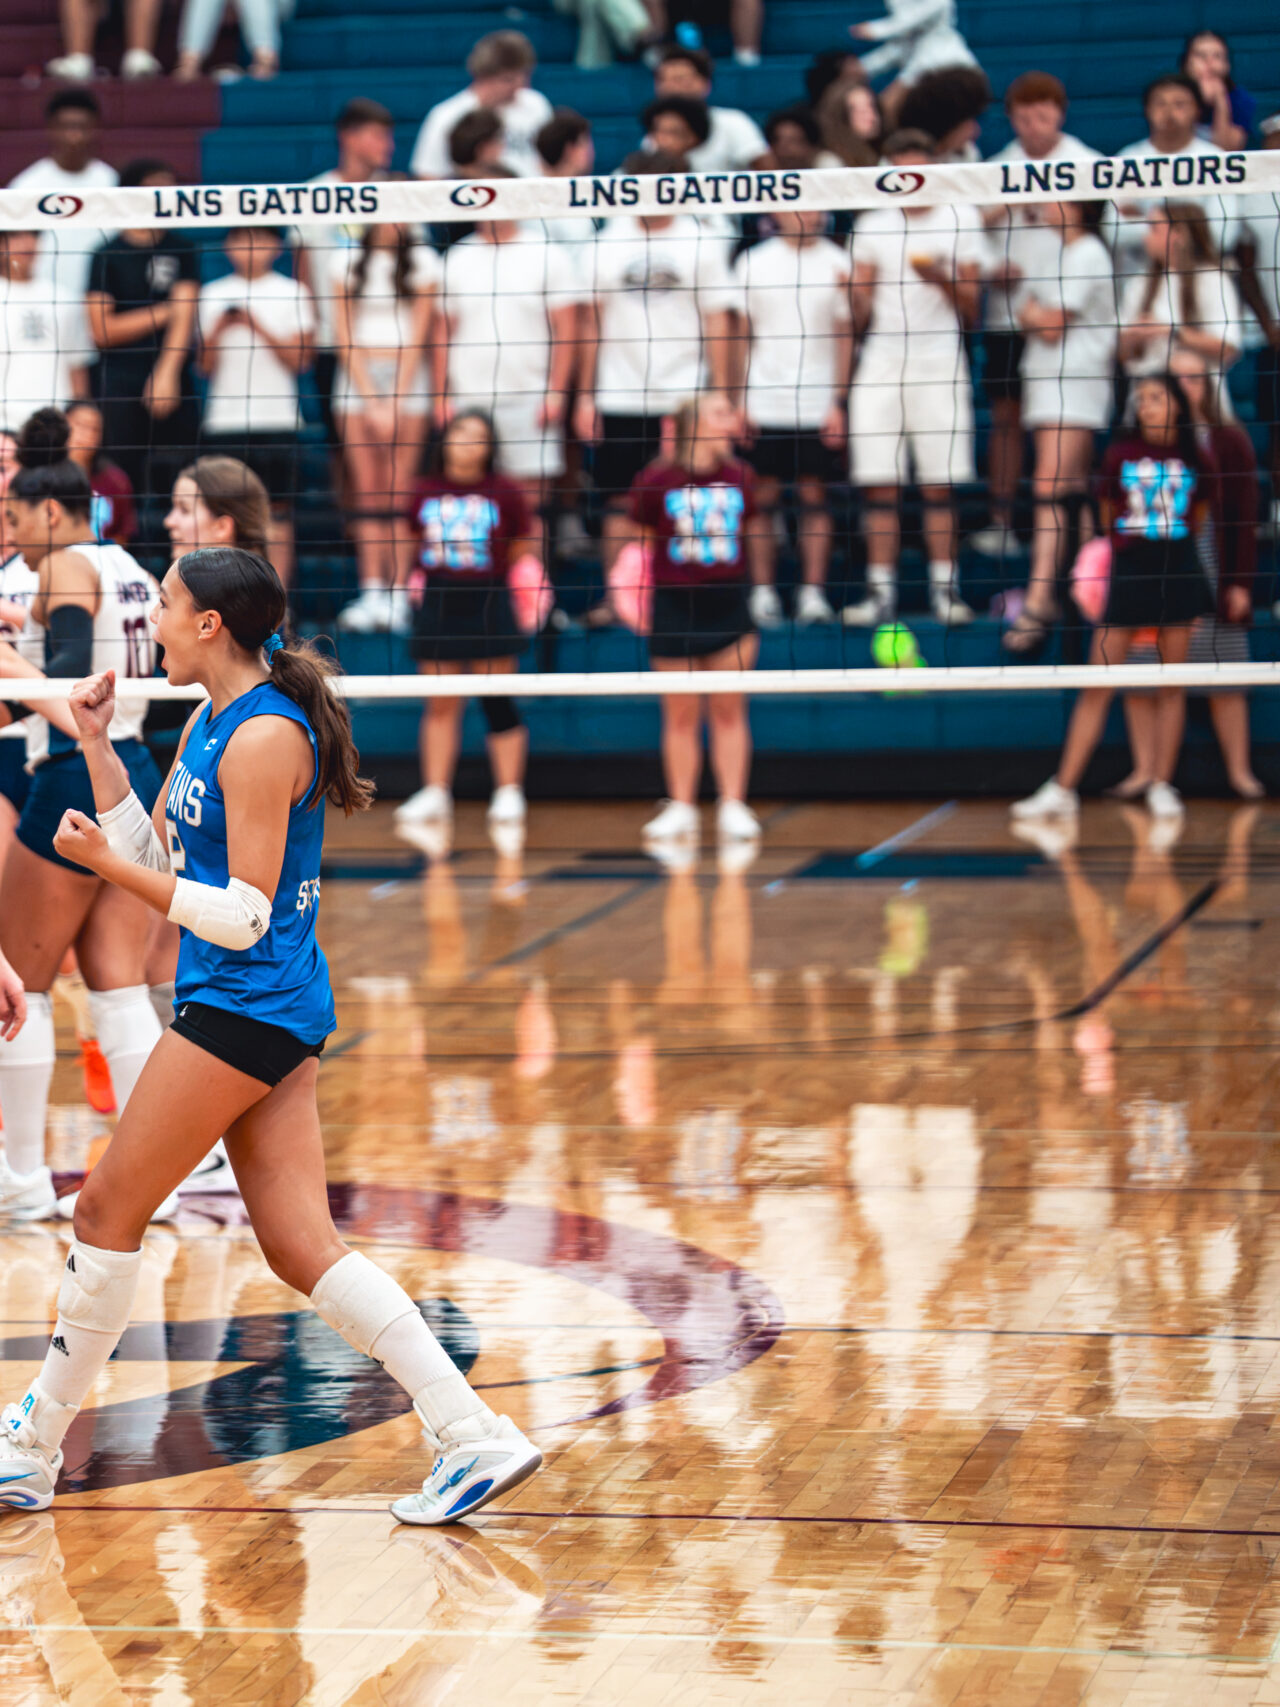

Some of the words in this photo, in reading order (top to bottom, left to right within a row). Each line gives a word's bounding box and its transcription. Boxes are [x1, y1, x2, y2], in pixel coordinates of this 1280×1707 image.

[569, 178, 639, 207] LNS
[656, 173, 801, 205] GATORS
[1001, 162, 1075, 193] LNS
[1092, 154, 1246, 189] GATORS
[154, 189, 222, 218] LNS
[239, 186, 378, 216] GATORS
